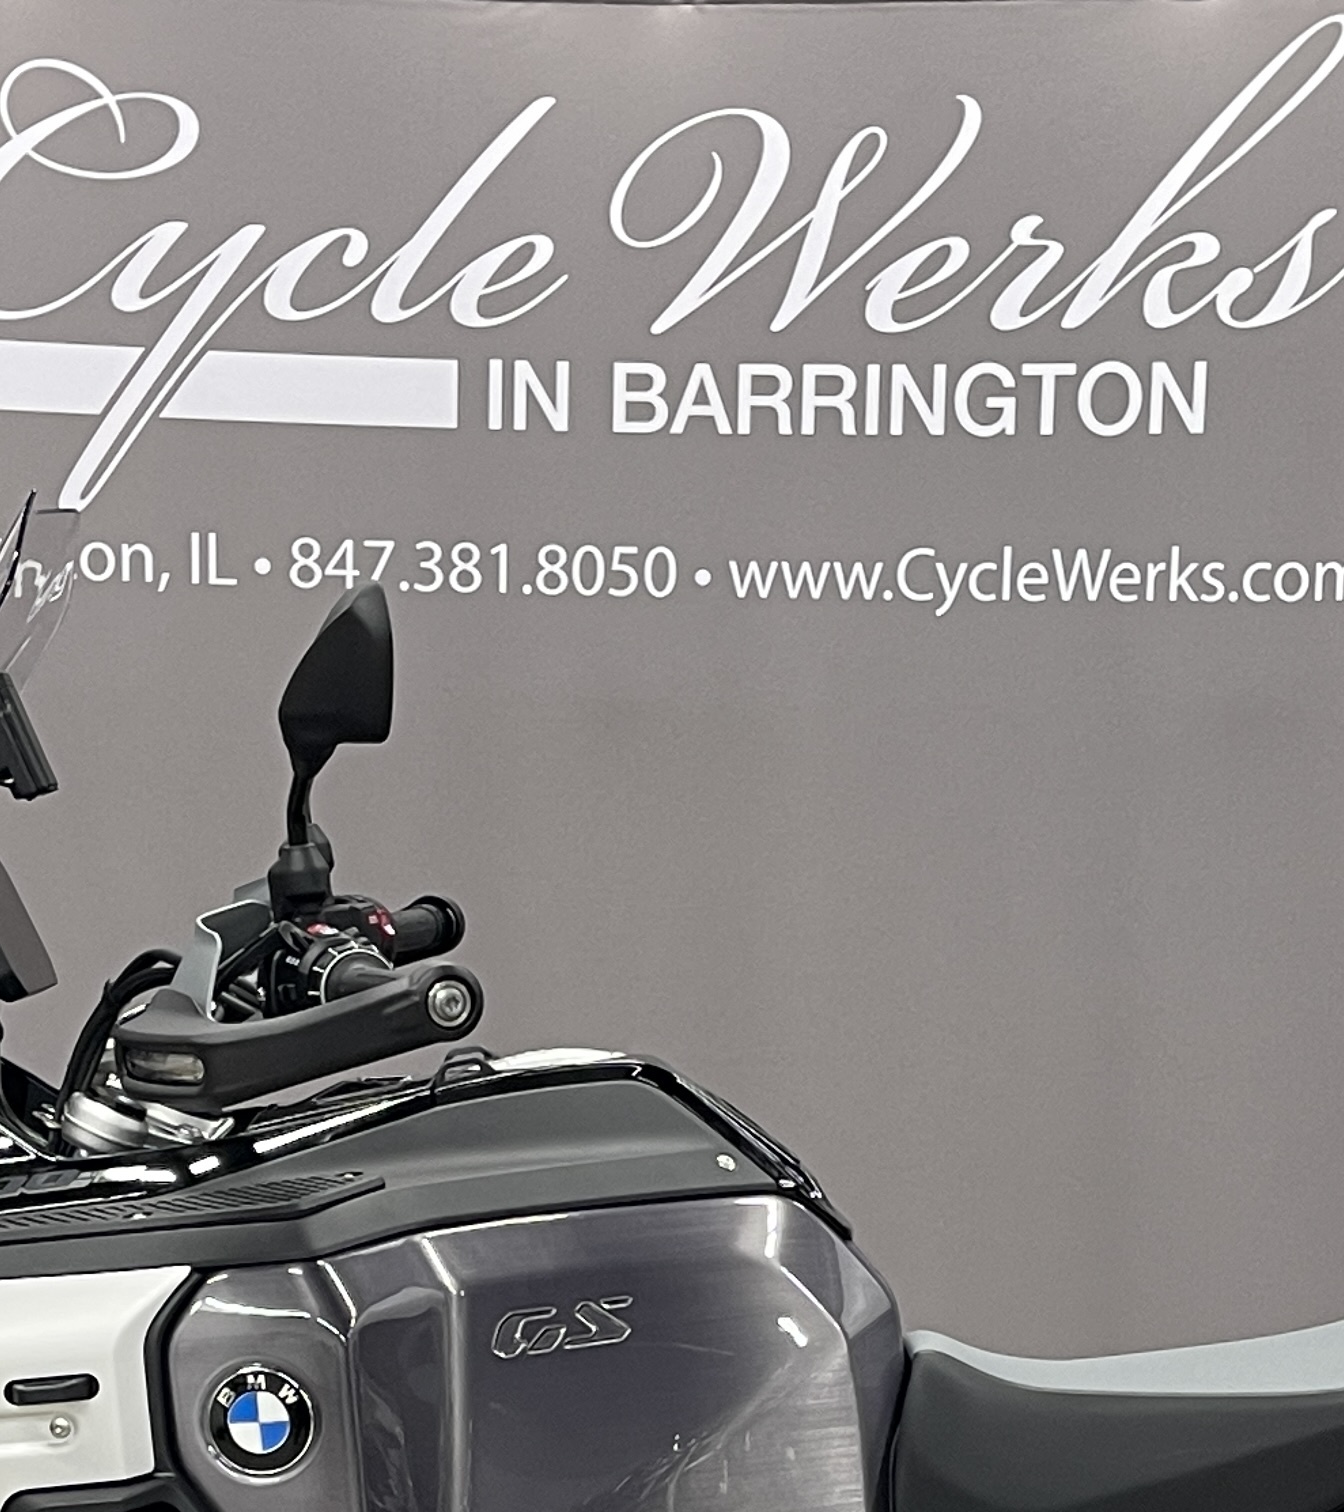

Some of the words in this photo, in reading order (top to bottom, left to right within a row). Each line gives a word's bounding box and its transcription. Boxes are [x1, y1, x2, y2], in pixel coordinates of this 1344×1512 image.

[487, 358, 571, 433] IN
[611, 360, 1209, 438] BARRINGTON
[190, 531, 239, 587] IL
[288, 536, 678, 599] 847.381.8050
[490, 1295, 633, 1359] GS
[216, 1373, 300, 1408] BMW
